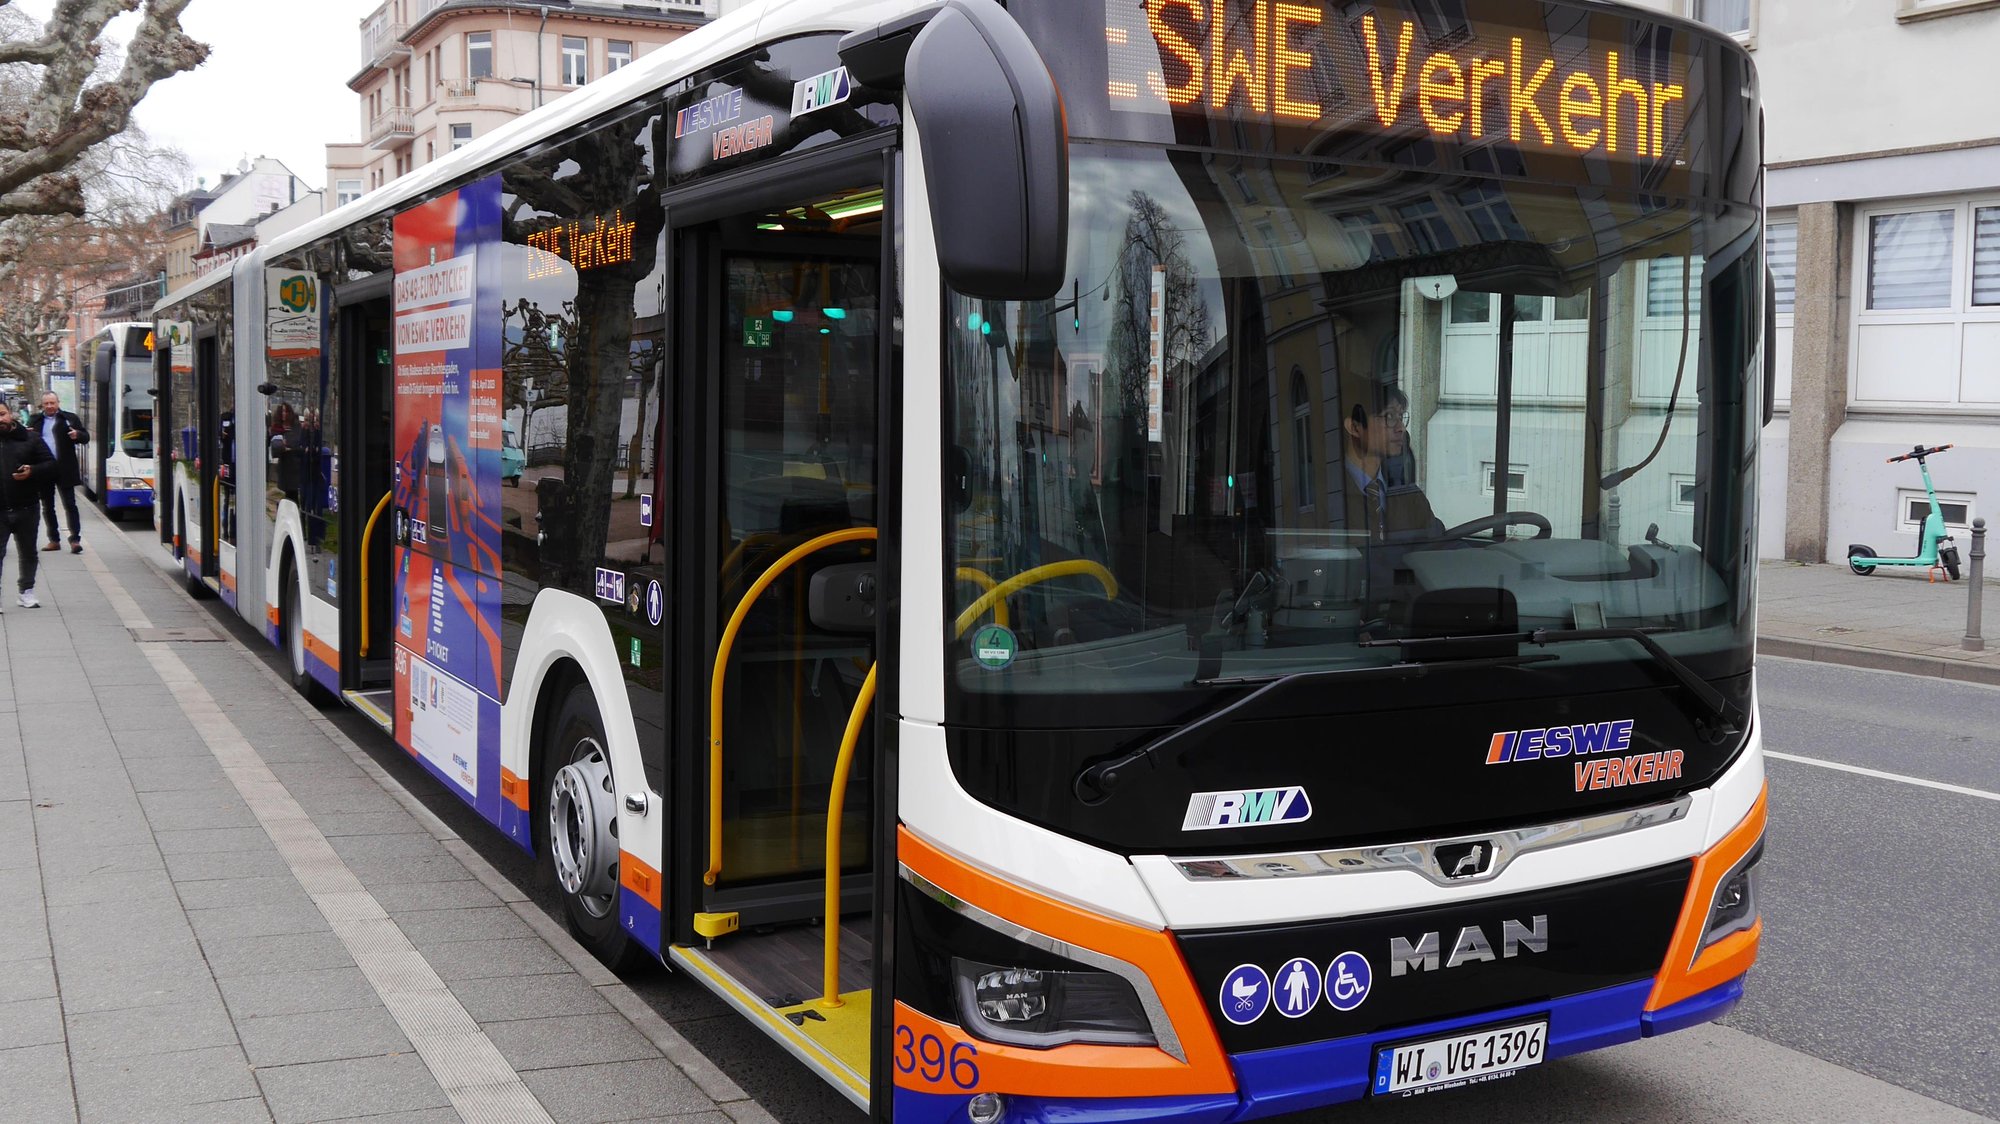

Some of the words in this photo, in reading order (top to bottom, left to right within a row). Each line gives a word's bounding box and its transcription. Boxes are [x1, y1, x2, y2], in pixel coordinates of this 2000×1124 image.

[801, 67, 846, 111] RMV
[1362, 15, 1684, 157] Verkehr
[686, 87, 743, 135] ESWE
[712, 114, 774, 161] VERKEHR
[527, 226, 562, 279] ESWE
[568, 209, 636, 268] Verkehr
[397, 280, 409, 304] DAS
[397, 322, 410, 346] VON
[411, 319, 429, 343] ESWE
[431, 314, 466, 342] VERKEHR
[427, 638, 449, 663] D-TICKET
[989, 629, 1000, 648] 4
[1513, 718, 1635, 760] ESWE
[1574, 749, 1685, 792] VERKEHR
[1210, 787, 1302, 826] RMV
[1389, 914, 1549, 977] MAN
[1006, 992, 1028, 1000] MAN
[894, 1024, 980, 1090] 396
[1379, 1076, 1386, 1086] D
[1396, 1048, 1425, 1085] WI
[1447, 1039, 1477, 1075] VG
[1481, 1027, 1541, 1069] 1396
